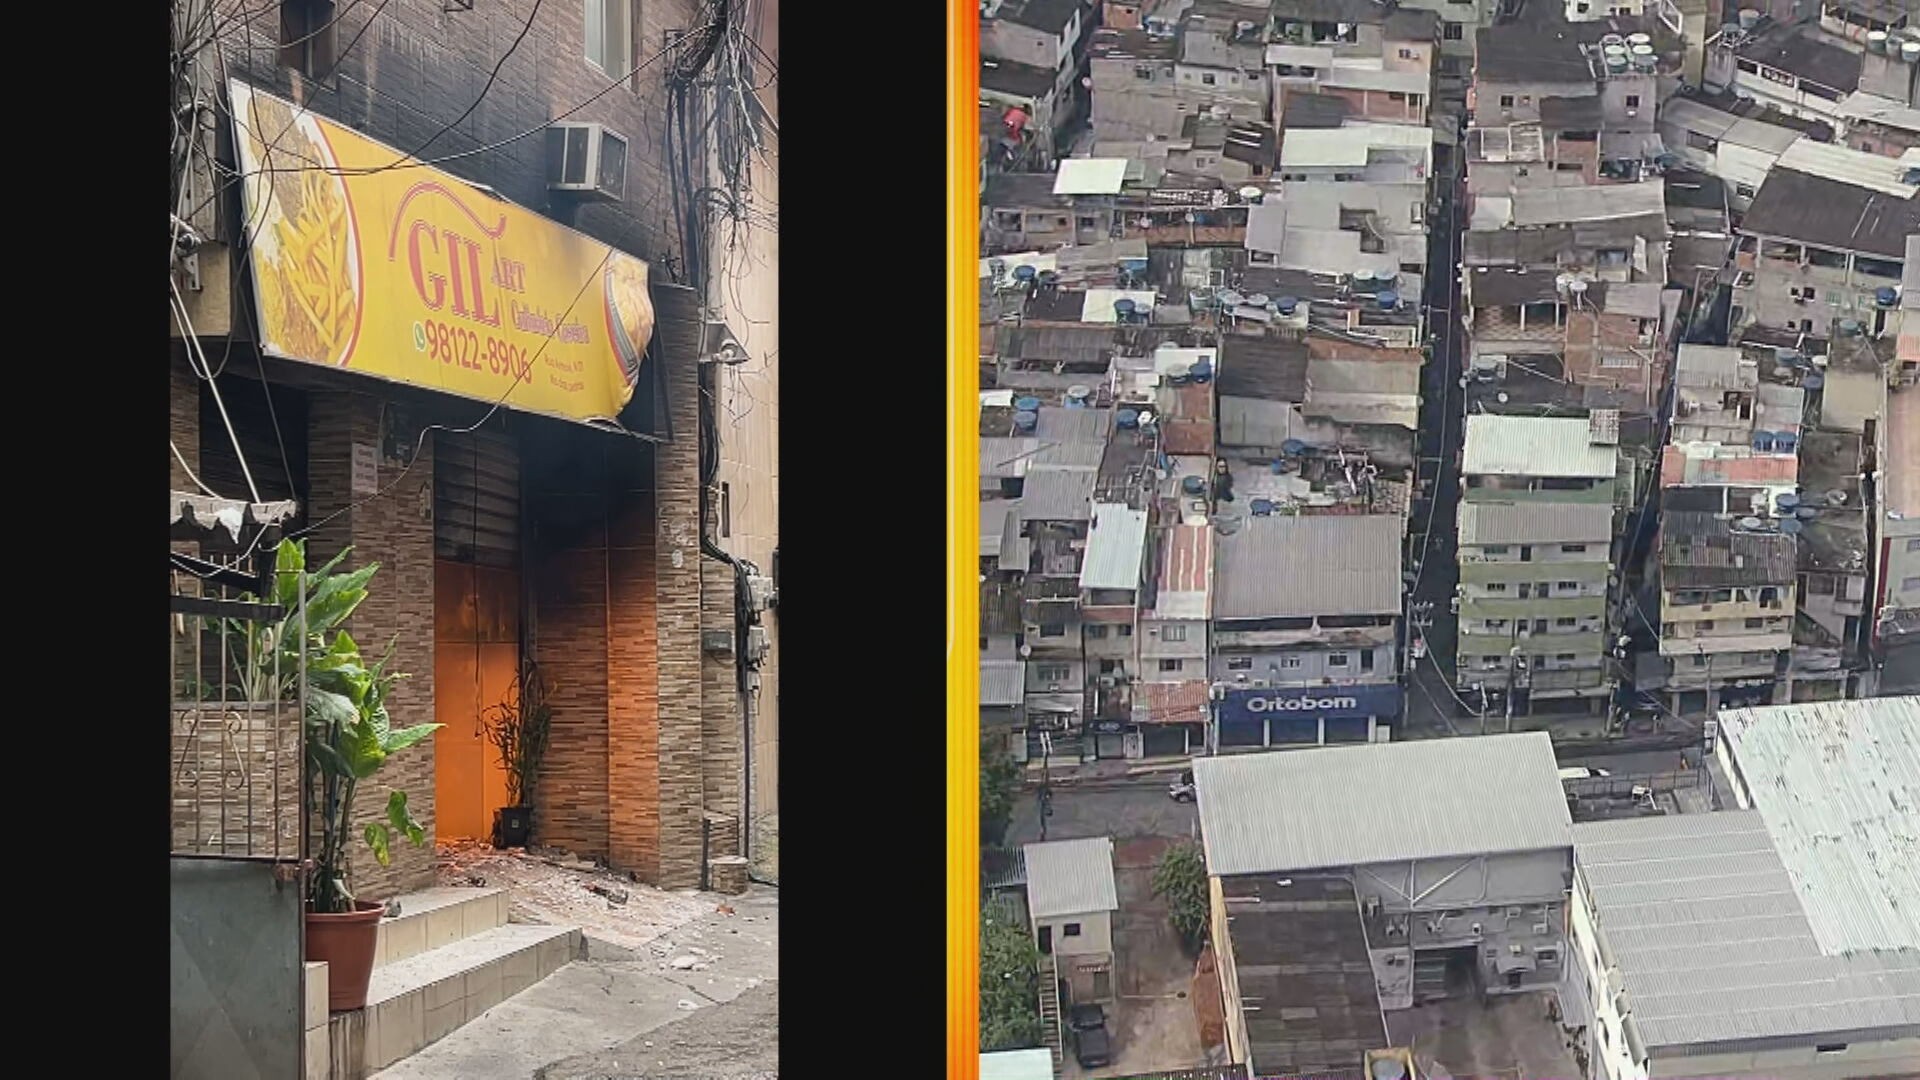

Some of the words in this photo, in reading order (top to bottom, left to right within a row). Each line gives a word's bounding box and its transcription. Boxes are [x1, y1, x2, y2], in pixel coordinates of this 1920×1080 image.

[408, 219, 500, 328] GIL
[425, 319, 532, 384] 98122-8906
[1247, 695, 1357, 712] Ortobom
